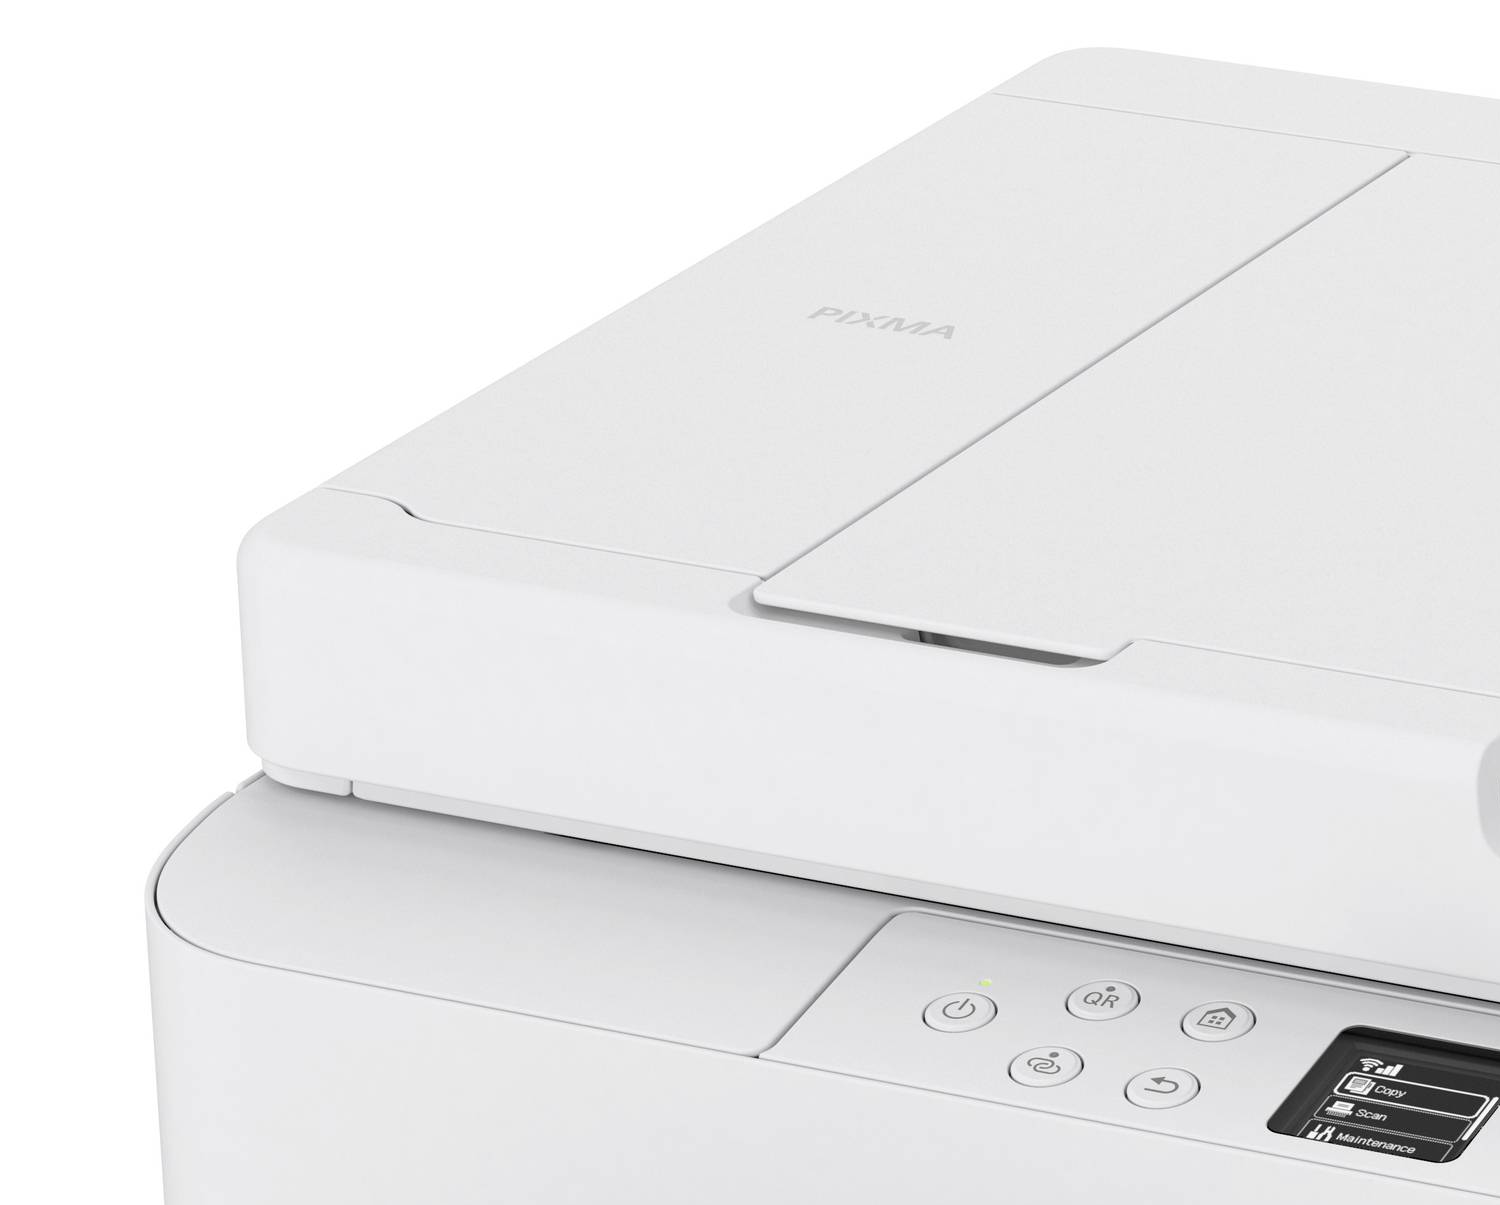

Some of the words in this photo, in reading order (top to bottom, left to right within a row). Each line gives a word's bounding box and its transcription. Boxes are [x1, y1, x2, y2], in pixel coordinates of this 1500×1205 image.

[807, 306, 955, 340] PIXMA
[1083, 990, 1120, 1010] QR
[1374, 1085, 1408, 1099] Copy
[1355, 1108, 1388, 1122] Scan
[1336, 1132, 1416, 1155] Maintenance
